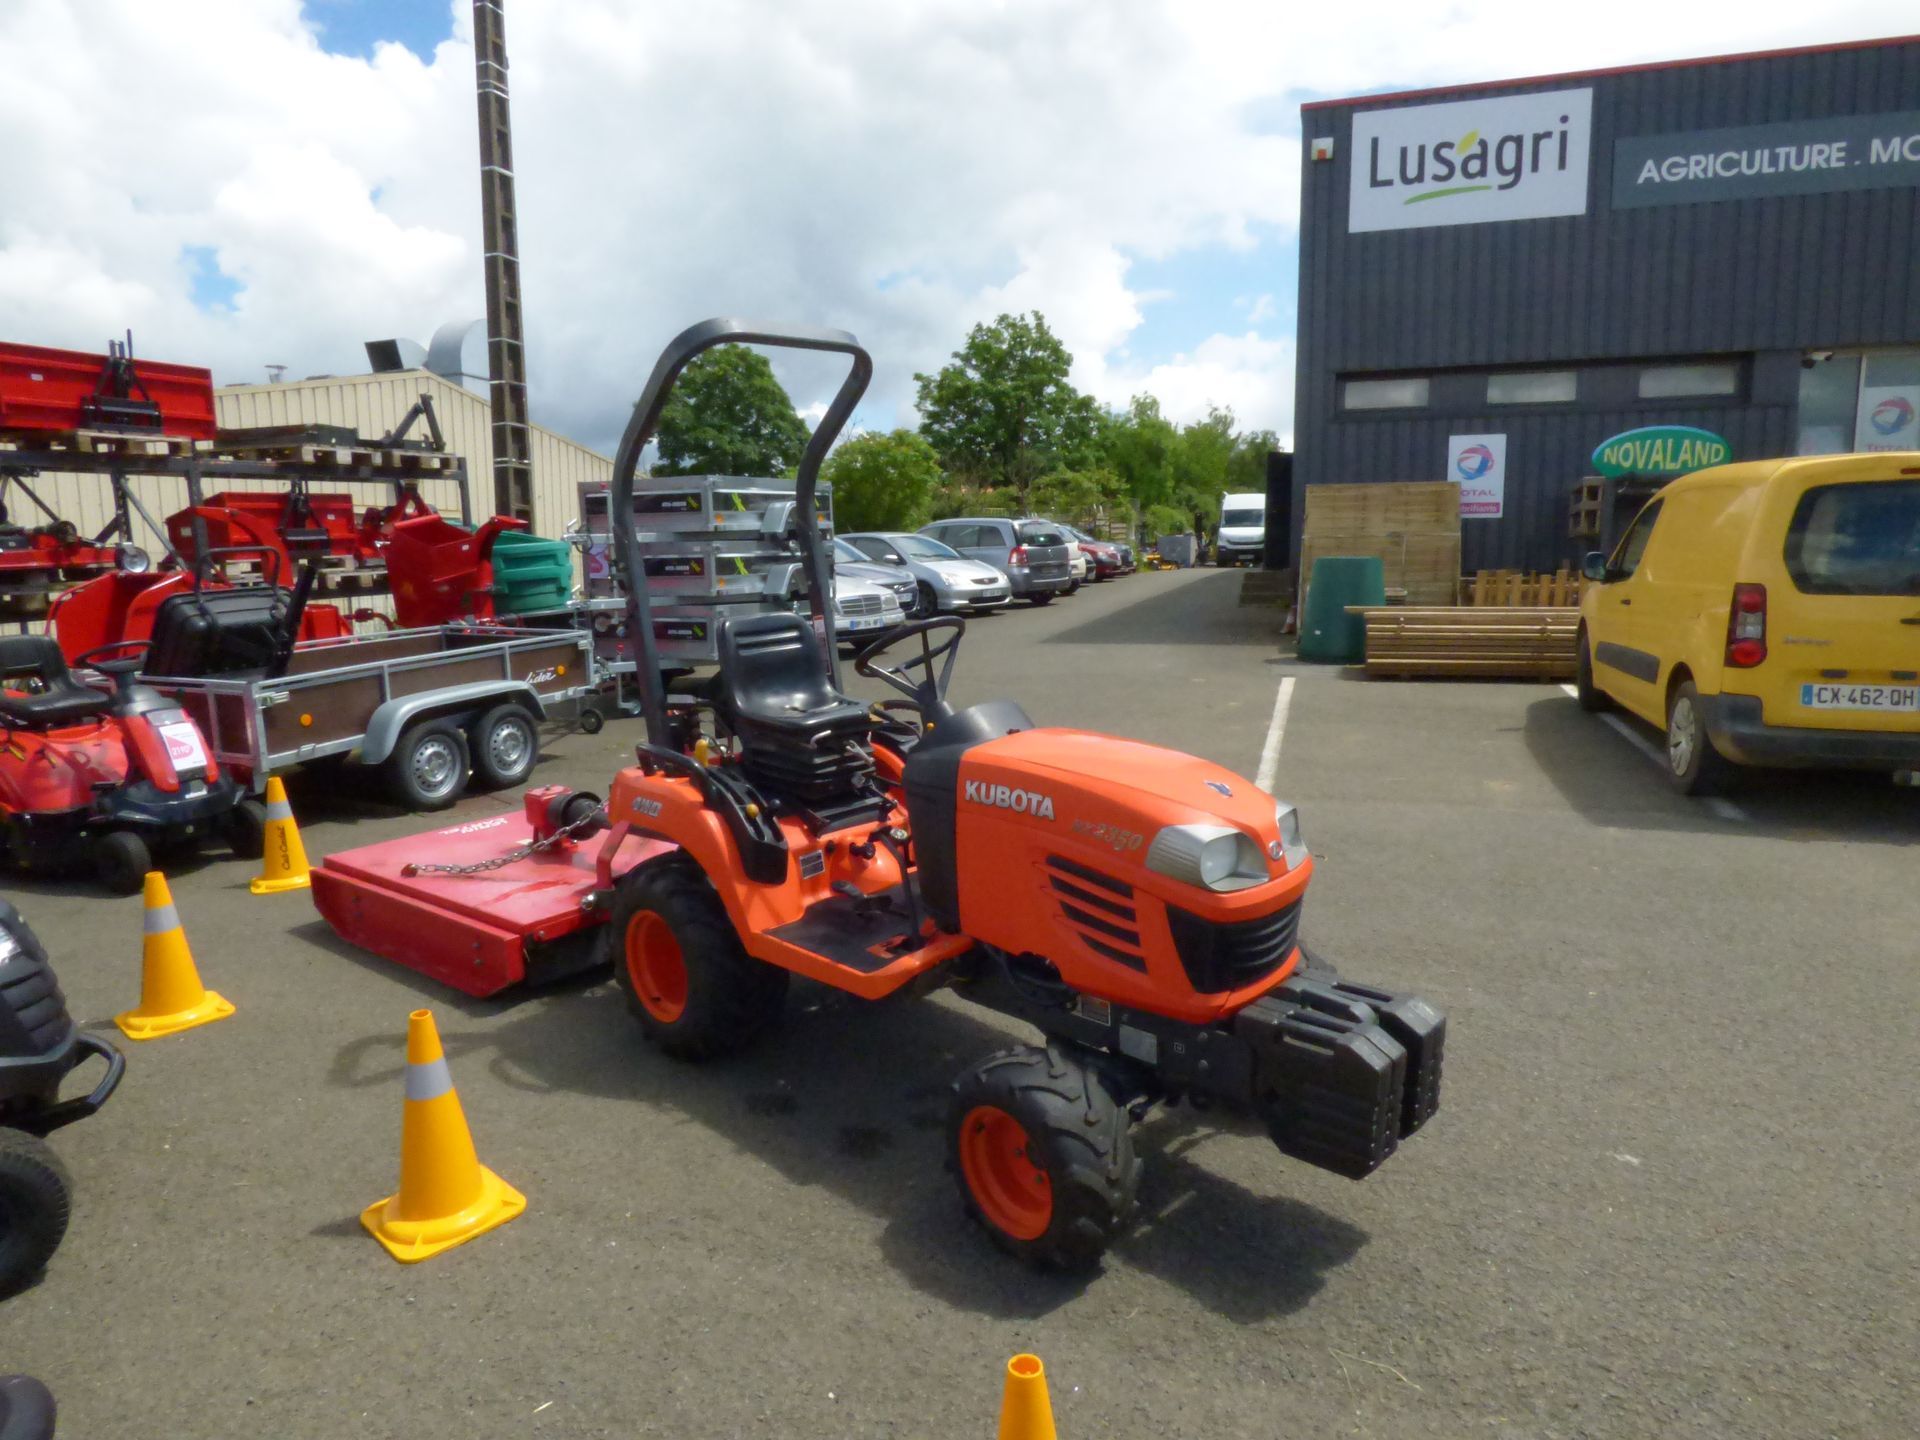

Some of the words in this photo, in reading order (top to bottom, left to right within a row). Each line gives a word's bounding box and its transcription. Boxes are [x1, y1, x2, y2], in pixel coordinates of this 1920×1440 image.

[1370, 115, 1569, 190] Lusagri
[1637, 142, 1847, 184] AGRICULTURE
[1603, 438, 1725, 470] NOVALAND
[1460, 489, 1495, 497] OTAL
[964, 779, 1056, 821] KUBOTA
